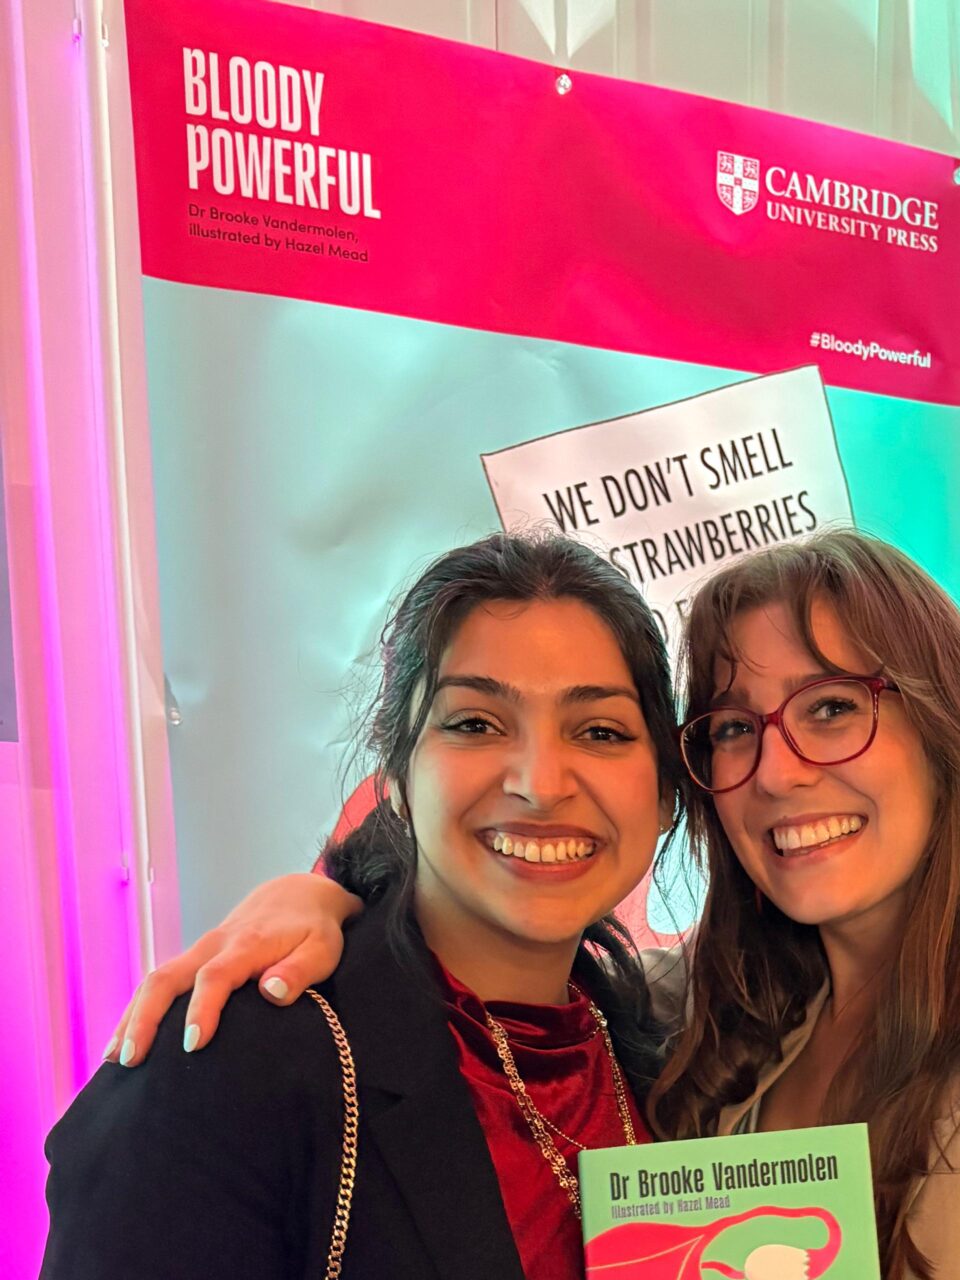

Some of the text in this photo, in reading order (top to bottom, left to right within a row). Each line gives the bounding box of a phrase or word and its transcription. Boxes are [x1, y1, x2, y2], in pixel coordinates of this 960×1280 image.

[182, 46, 324, 136] BLOODY
[186, 123, 382, 219] POWERFUL
[188, 203, 359, 244] Dr Brooke Vandermolen,
[765, 166, 939, 230] CAMBRIDGE
[188, 223, 369, 263] illustrated by Hazel Mead
[765, 200, 939, 253] UNIVERSITY PRESS
[809, 332, 932, 368] #BloodyPowerful
[542, 427, 793, 534] WE DON'T SMELL
[609, 490, 818, 584] STRAWBERRIES
[609, 1153, 839, 1201] Dr Brooke Vandermolen
[611, 1195, 731, 1219] Illustrated by Hazel Mead
